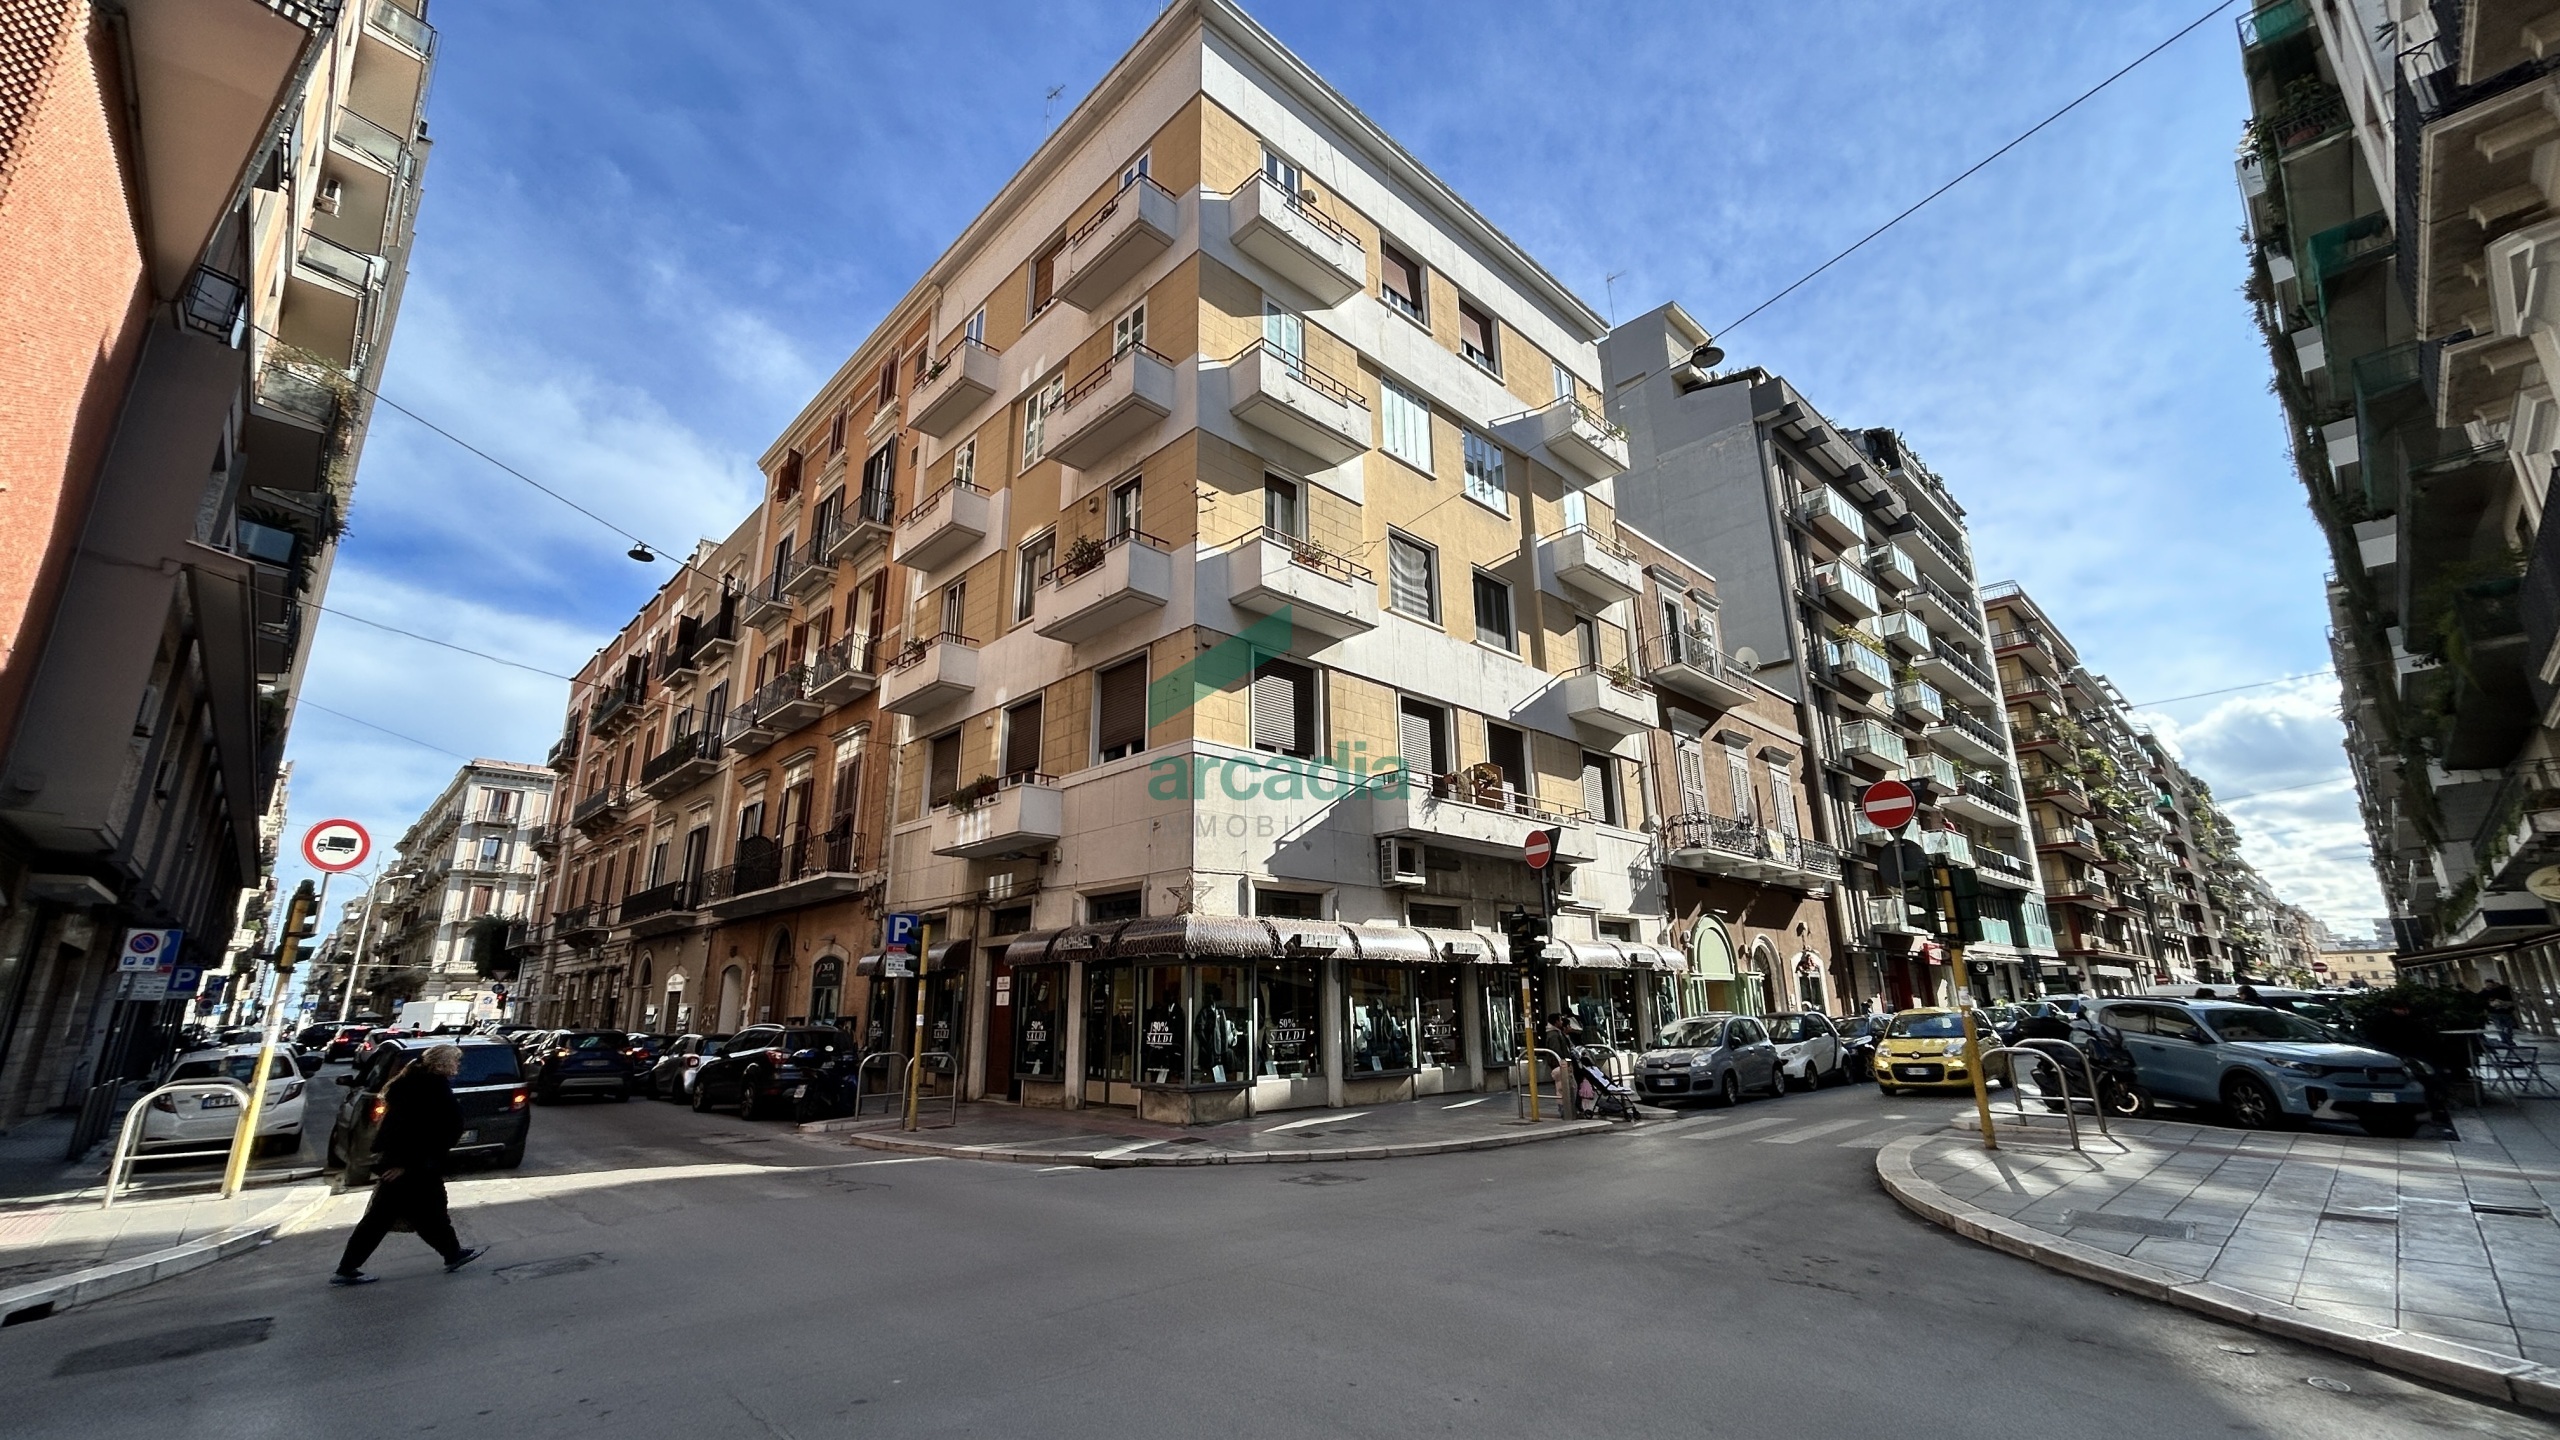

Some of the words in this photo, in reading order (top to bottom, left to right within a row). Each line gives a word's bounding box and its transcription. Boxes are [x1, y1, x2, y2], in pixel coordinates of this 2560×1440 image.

[893, 916, 913, 942] P
[172, 968, 196, 989] P
[1279, 1019, 1296, 1028] 50%
[1147, 1033, 1173, 1043] SALDI
[1270, 1030, 1306, 1041] SALDI
